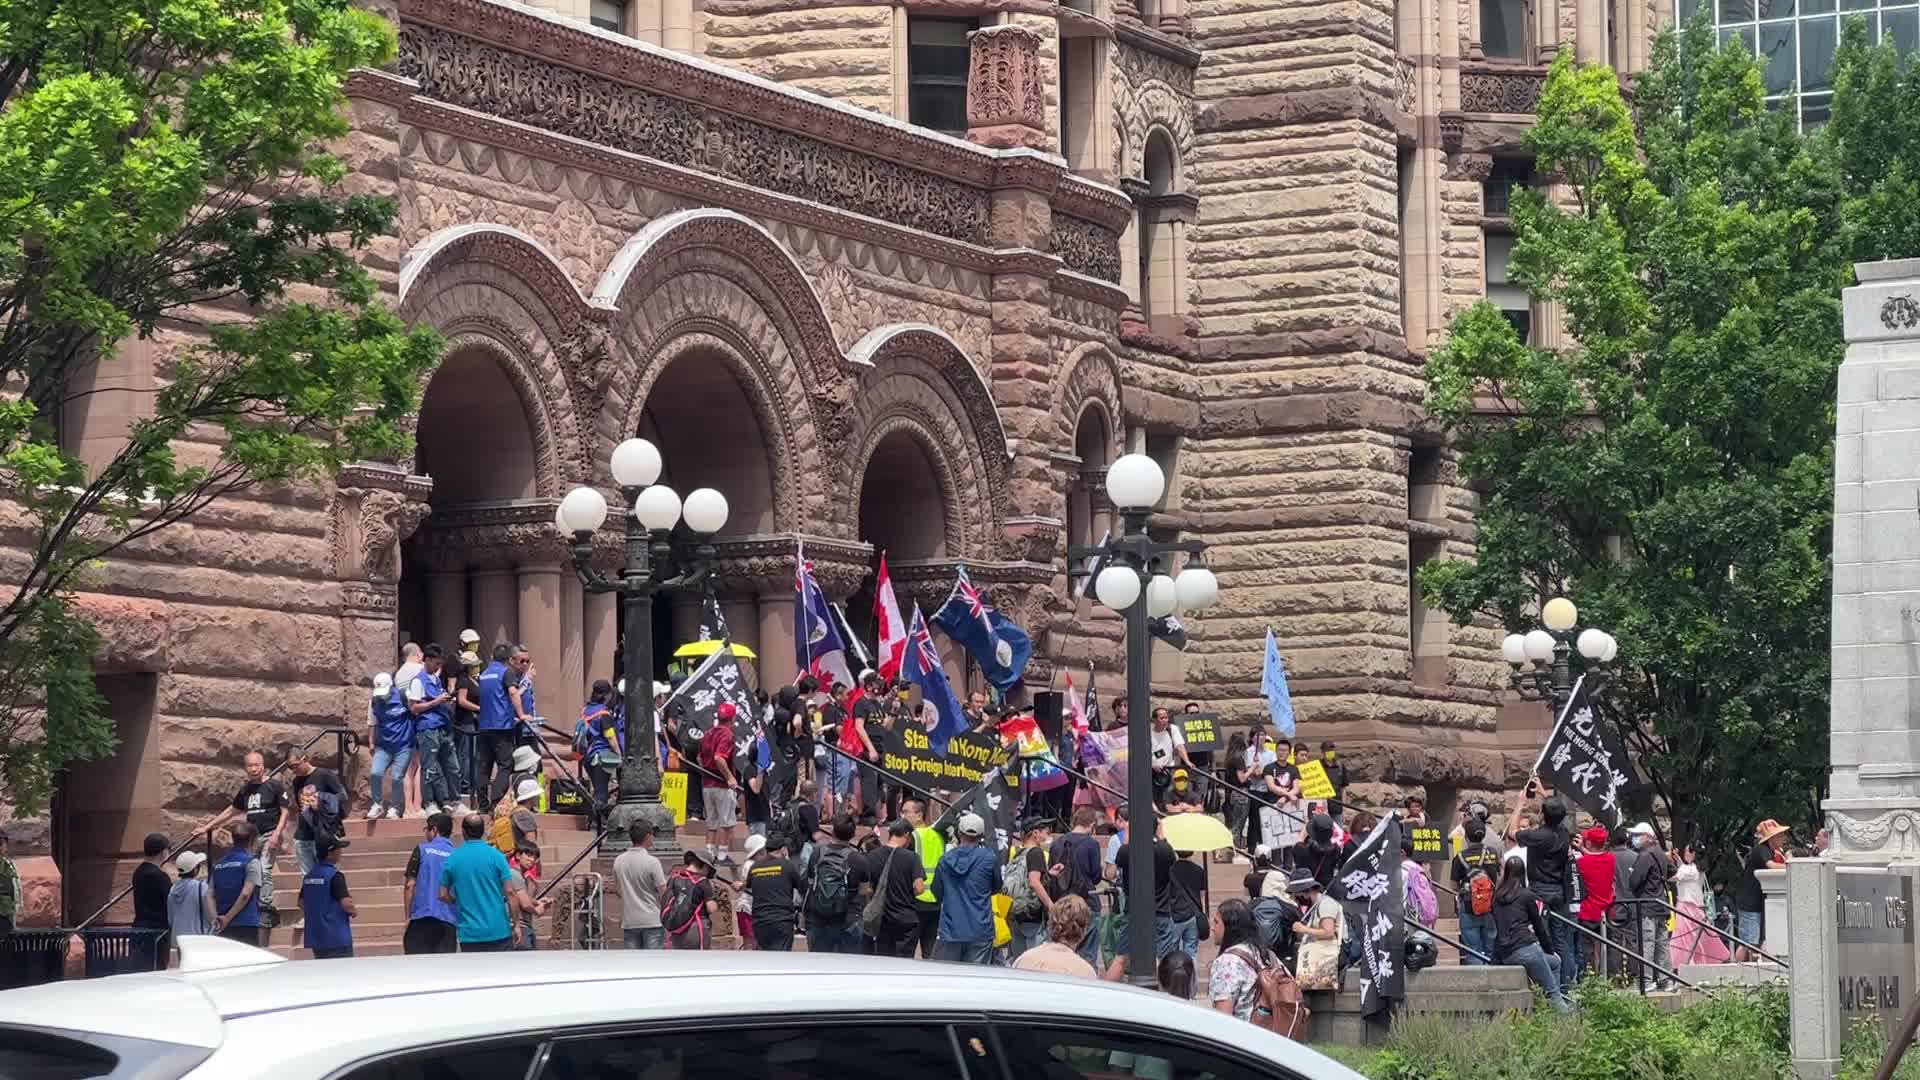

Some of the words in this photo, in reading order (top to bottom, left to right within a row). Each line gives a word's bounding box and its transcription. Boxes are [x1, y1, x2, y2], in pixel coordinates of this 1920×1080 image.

[904, 728, 929, 749] Sta
[1574, 735, 1596, 756] HONG
[885, 753, 909, 774] Stop
[911, 755, 943, 777] Foreign
[944, 760, 983, 783] Interferenc
